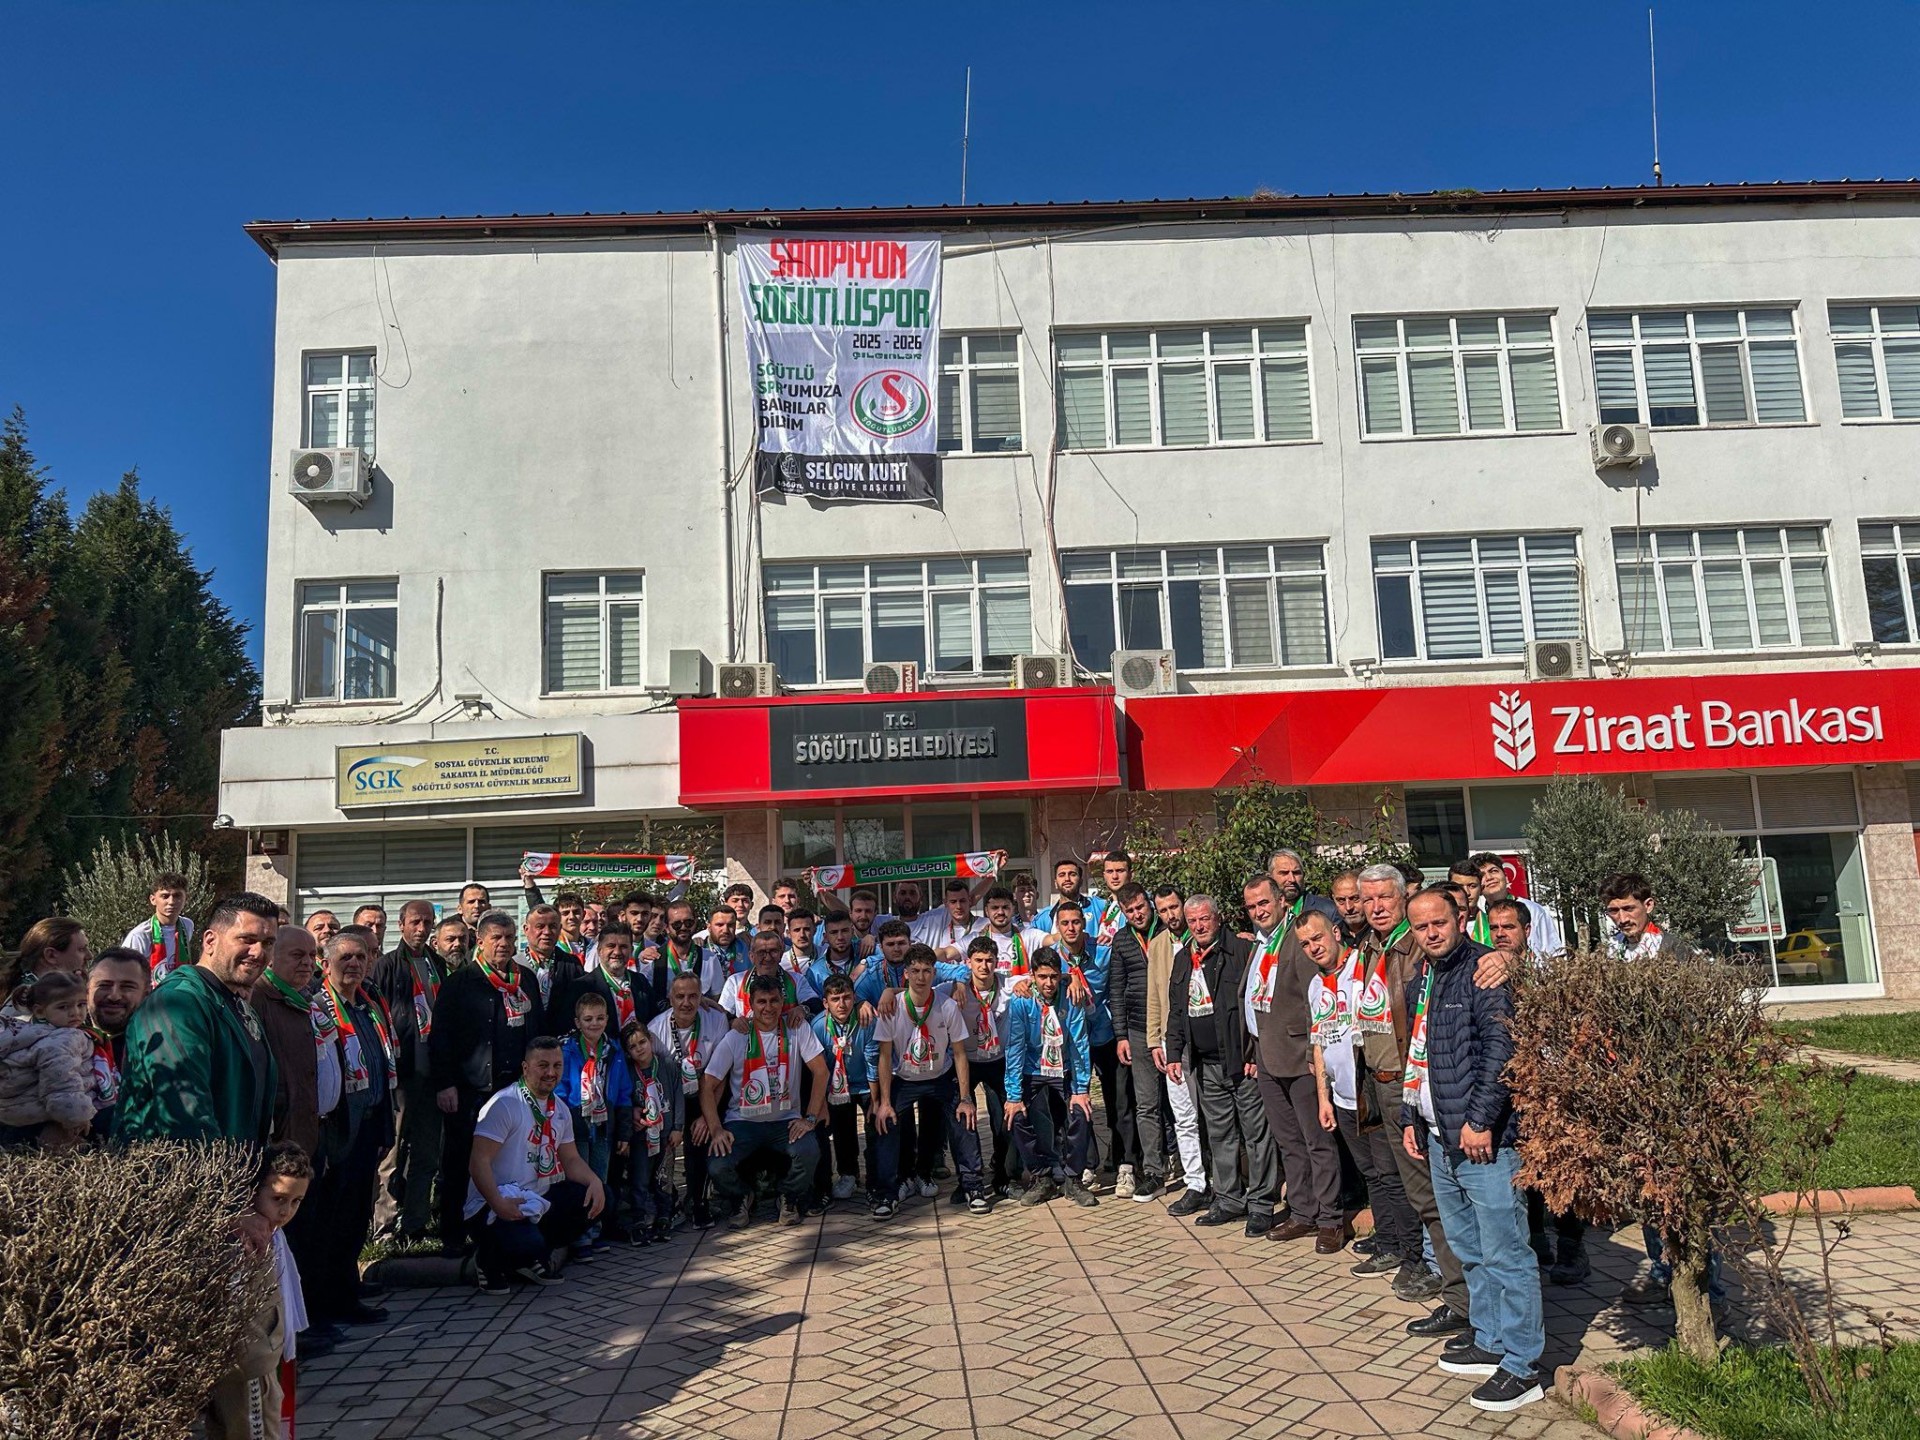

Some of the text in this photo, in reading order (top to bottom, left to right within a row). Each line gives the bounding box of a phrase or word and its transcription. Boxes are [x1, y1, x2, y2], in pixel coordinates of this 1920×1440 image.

[852, 333, 881, 349] 2025
[893, 335, 922, 350] 2026
[869, 462, 908, 482] KURT
[905, 664, 913, 693] REGAL
[885, 713, 914, 727] T.C.
[1551, 697, 1884, 754] Ziraat Bankası
[484, 747, 500, 755] T.C.
[796, 729, 995, 763] SÖĞÜTLÜ BELEDİYESİ
[434, 755, 549, 768] SOSYAL GÜVENLİK KURUMU
[355, 769, 404, 790] SGK
[440, 764, 543, 779] SAKARYA İL MÜDÜRLÜĞÜ
[411, 781, 452, 792] SÖĞÜTLÜ
[453, 781, 485, 790] SOSYAL
[486, 777, 530, 788] GÜVENLİK
[531, 775, 571, 786] MERKEZİ
